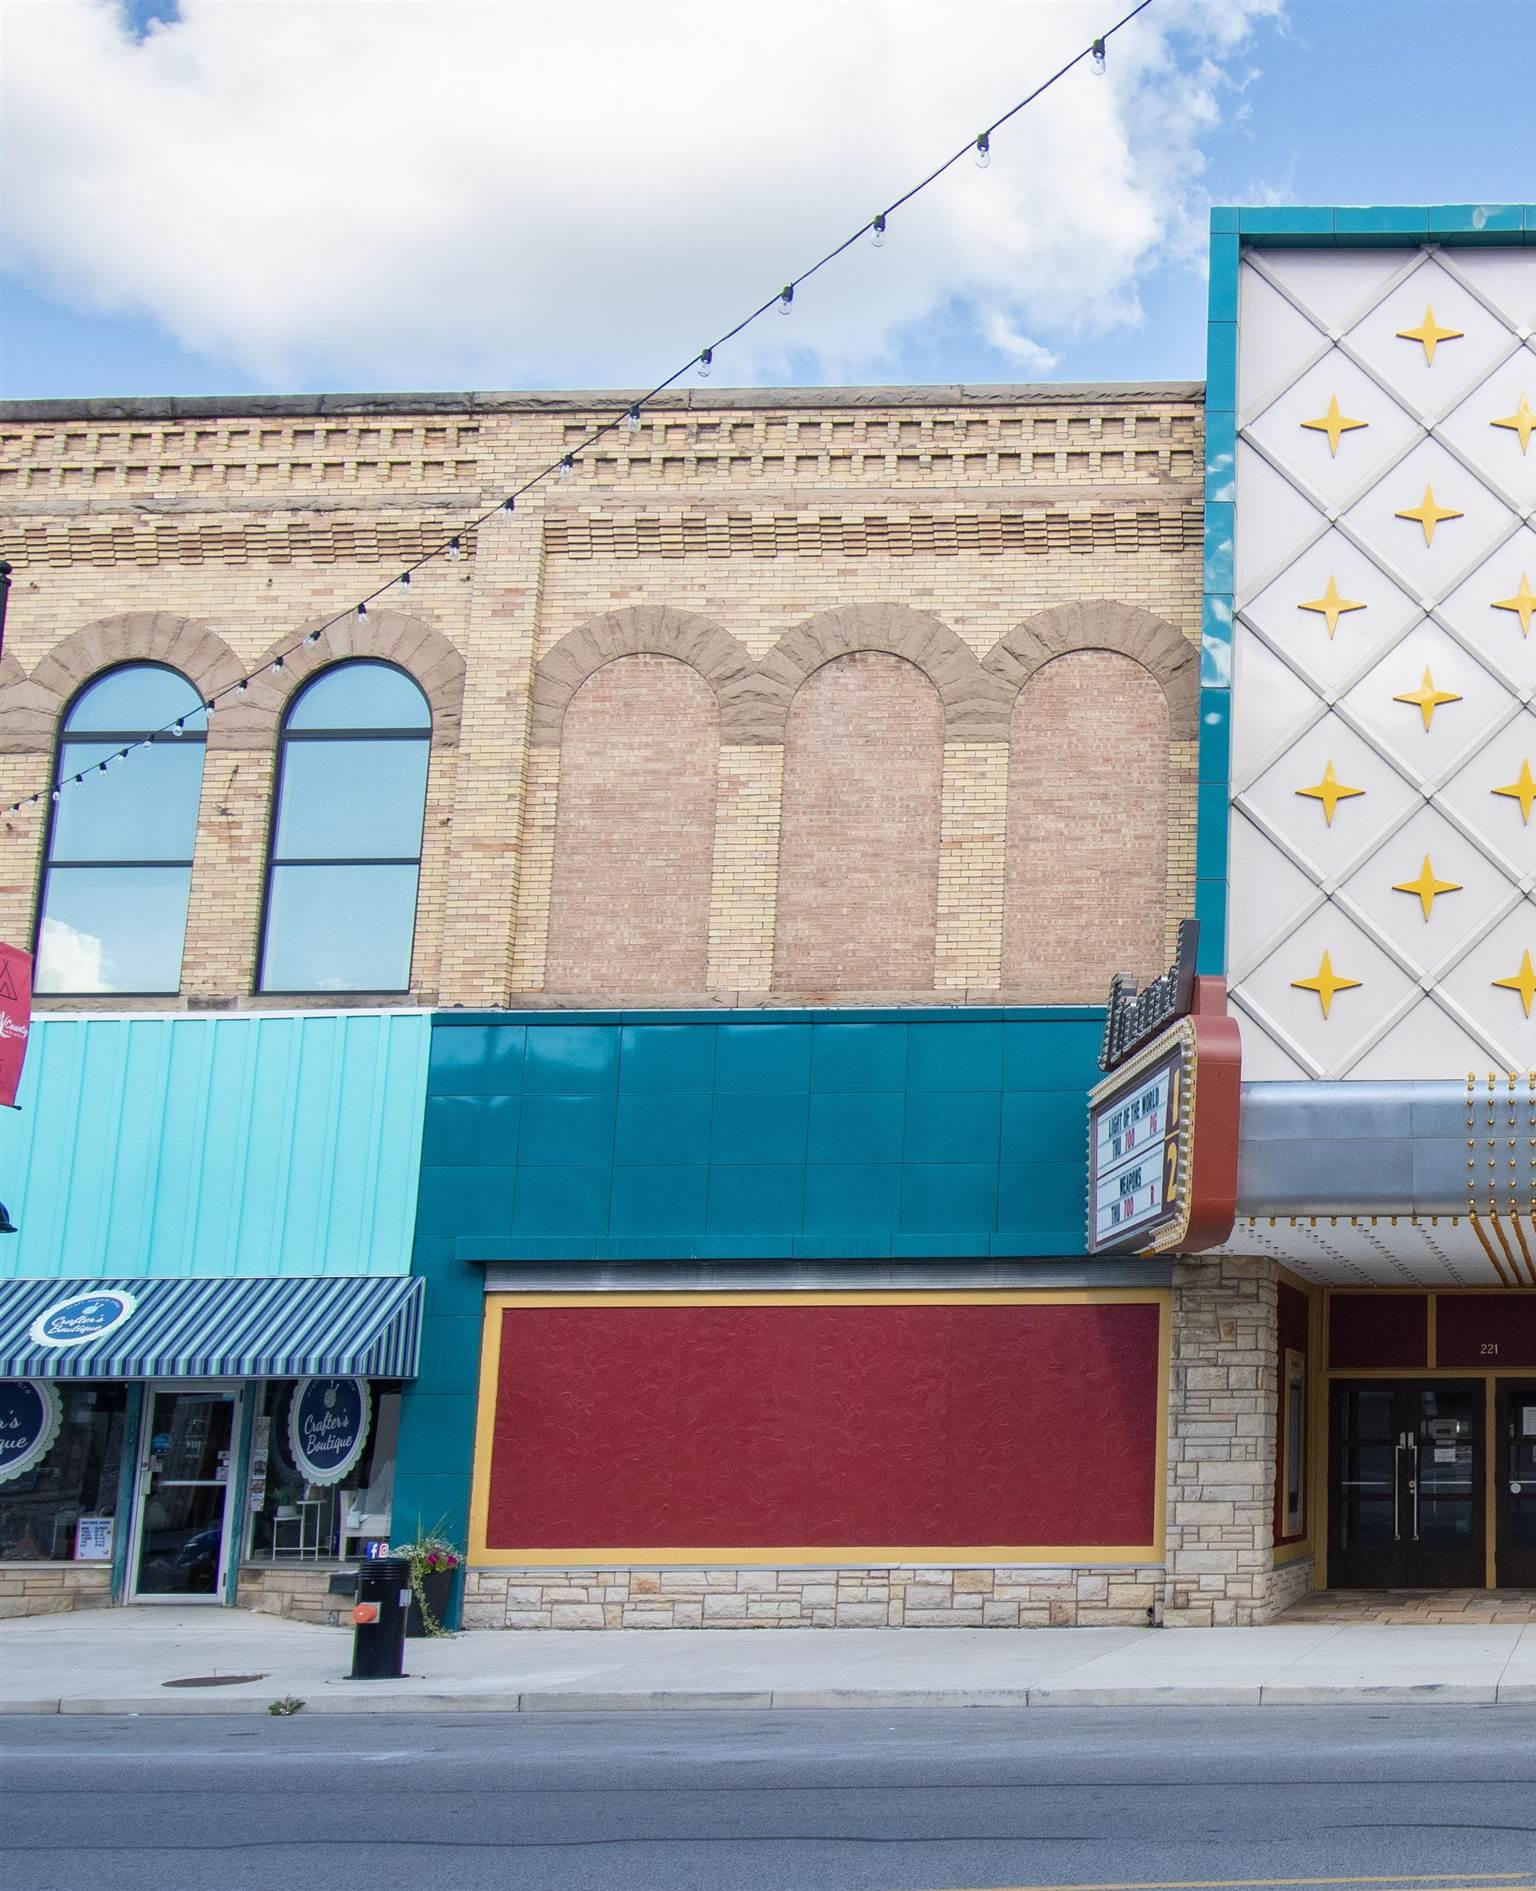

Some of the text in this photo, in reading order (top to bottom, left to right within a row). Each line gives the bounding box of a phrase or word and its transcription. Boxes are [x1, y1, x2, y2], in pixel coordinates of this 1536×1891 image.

[1108, 1087, 1160, 1138] LIGHT OF THE WORLD
[1112, 1111, 1158, 1160] THU 700 PG
[1119, 1166, 1142, 1196] WEAPONS
[1167, 1141, 1178, 1203] 2
[1111, 1202, 1121, 1225] THU
[1124, 1195, 1134, 1219] 700
[47, 1325, 103, 1335] Boutique
[51, 1314, 105, 1326] Crafter's
[1480, 1343, 1498, 1355] 221
[304, 1408, 350, 1437] Crafter's
[306, 1433, 353, 1455] Boutique
